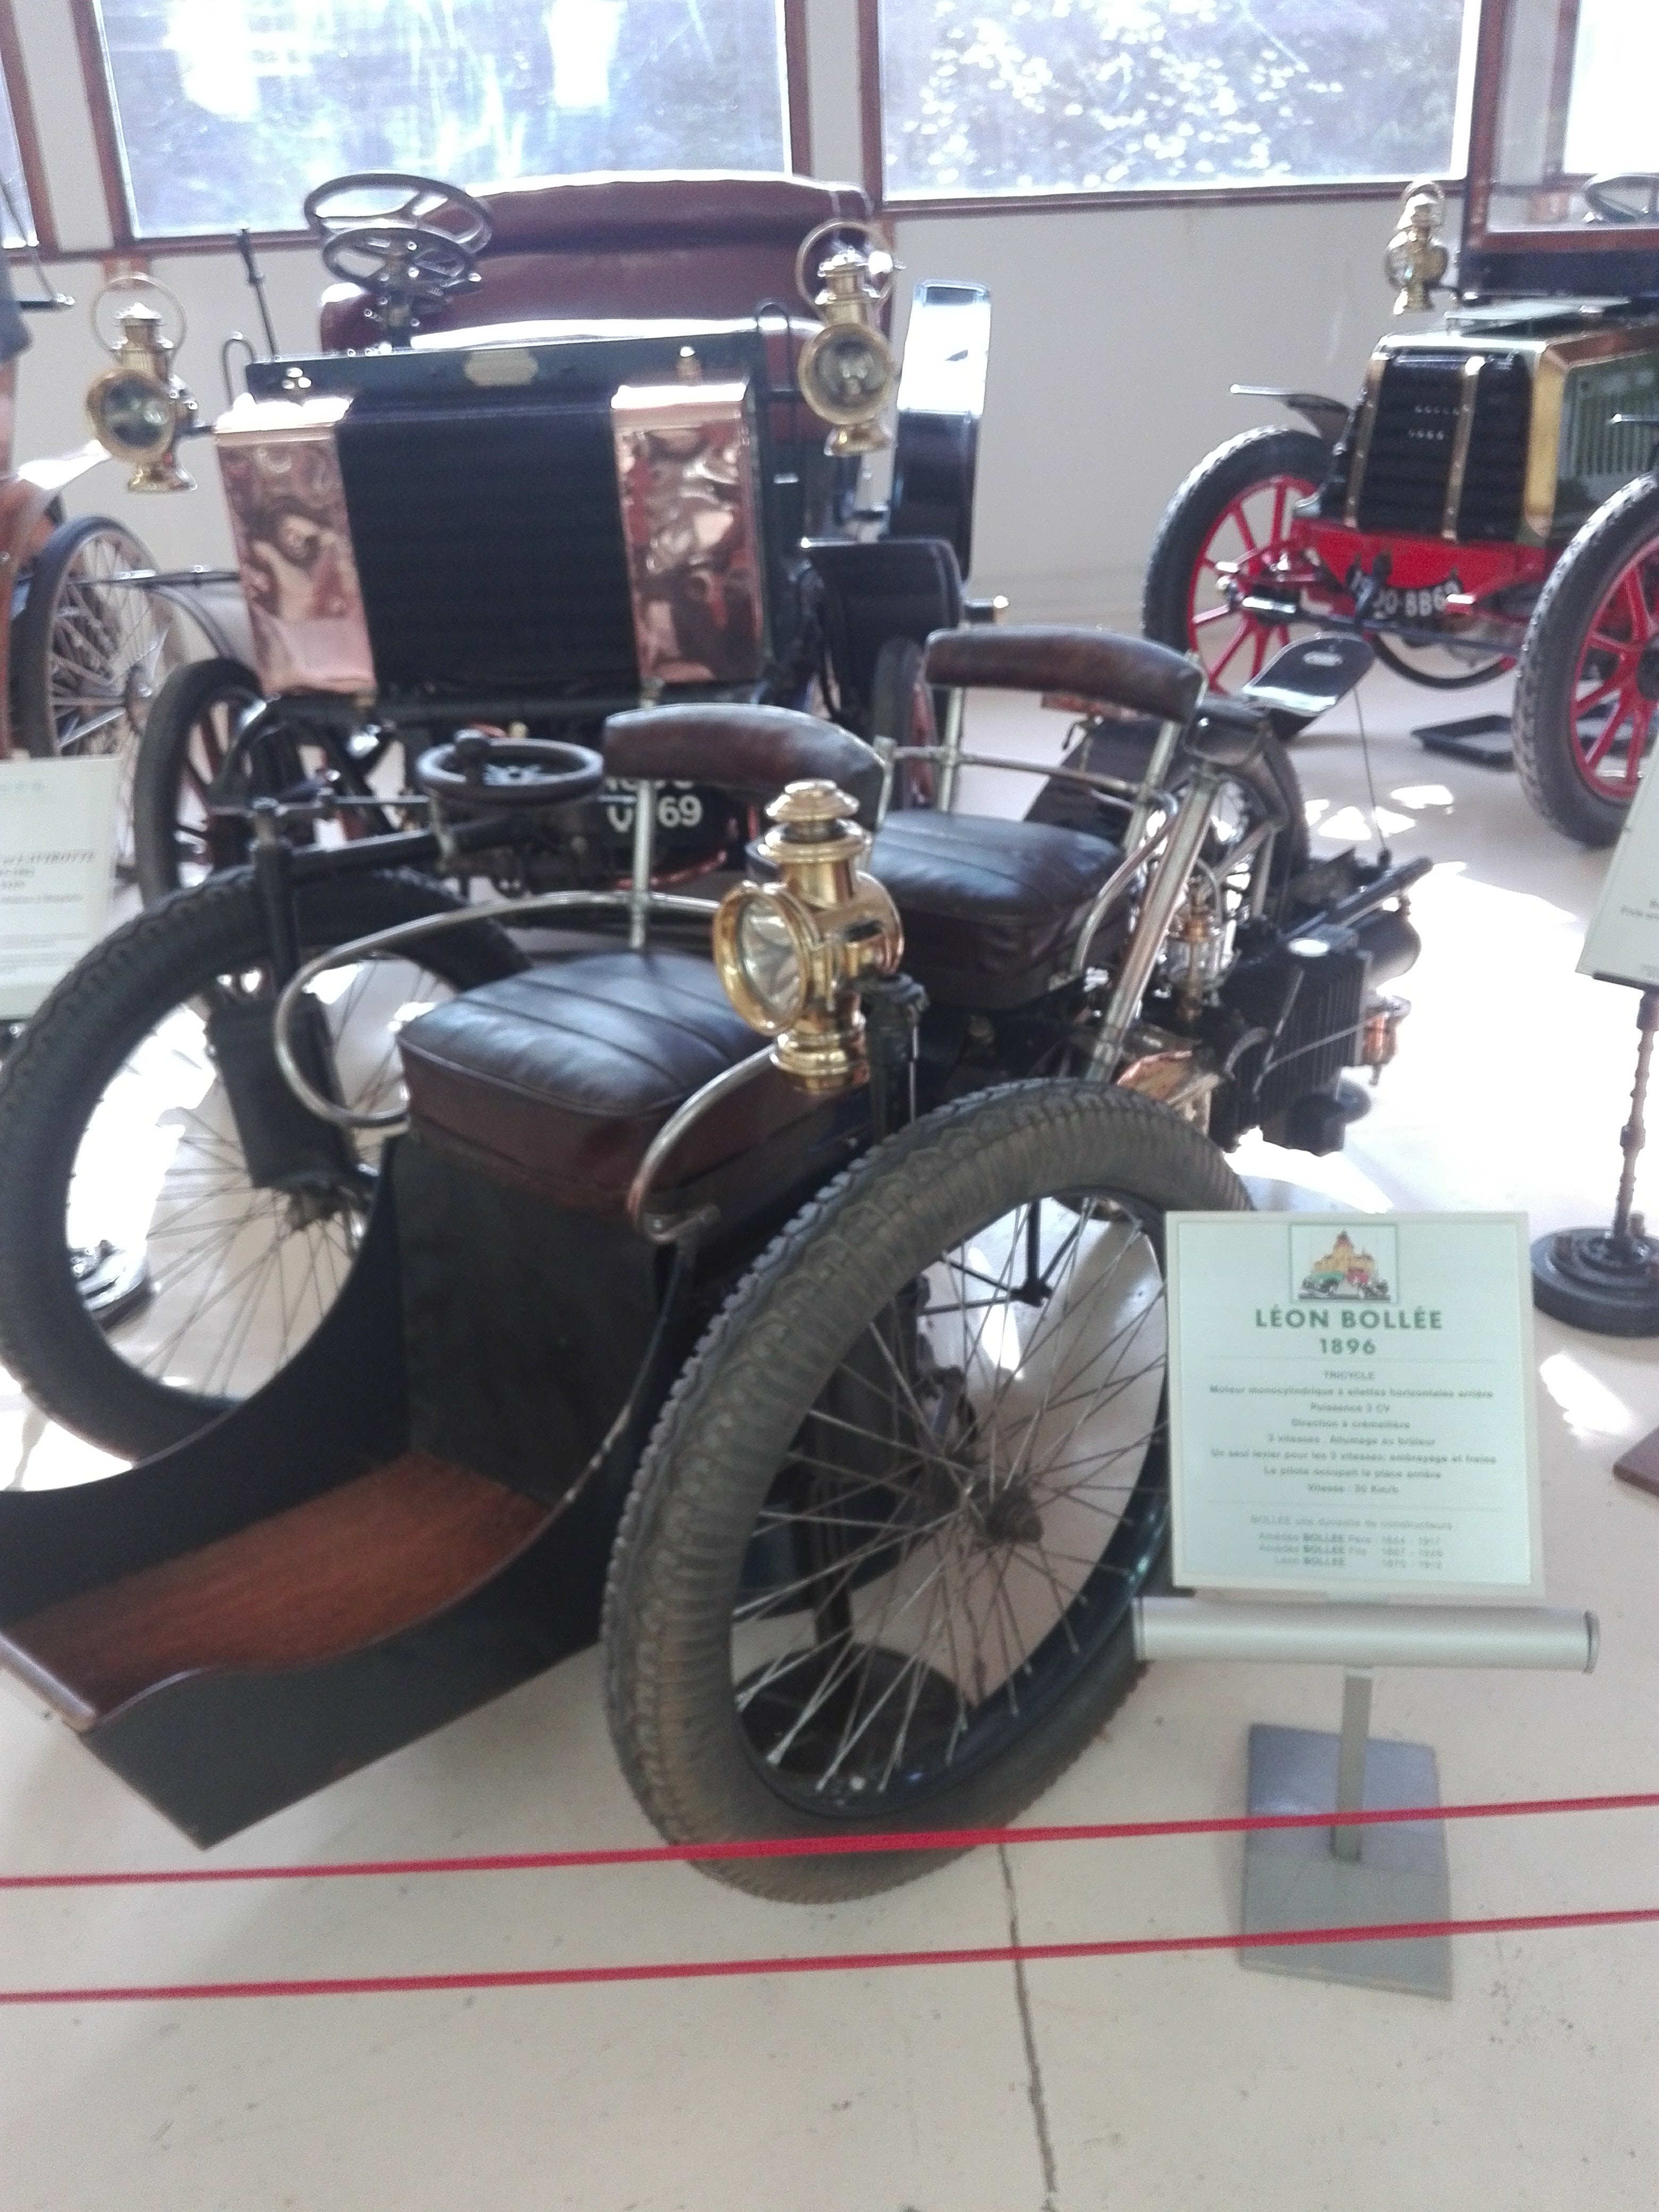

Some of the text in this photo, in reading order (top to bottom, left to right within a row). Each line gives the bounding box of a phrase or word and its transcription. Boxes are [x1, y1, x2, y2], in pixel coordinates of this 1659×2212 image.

[657, 795, 703, 827] 69
[1255, 1304, 1442, 1328] LÉON BOLLÉE
[1320, 1337, 1377, 1355] 1896
[1324, 1370, 1375, 1379] TRICYCLE
[1210, 1385, 1245, 1394] Moteur
